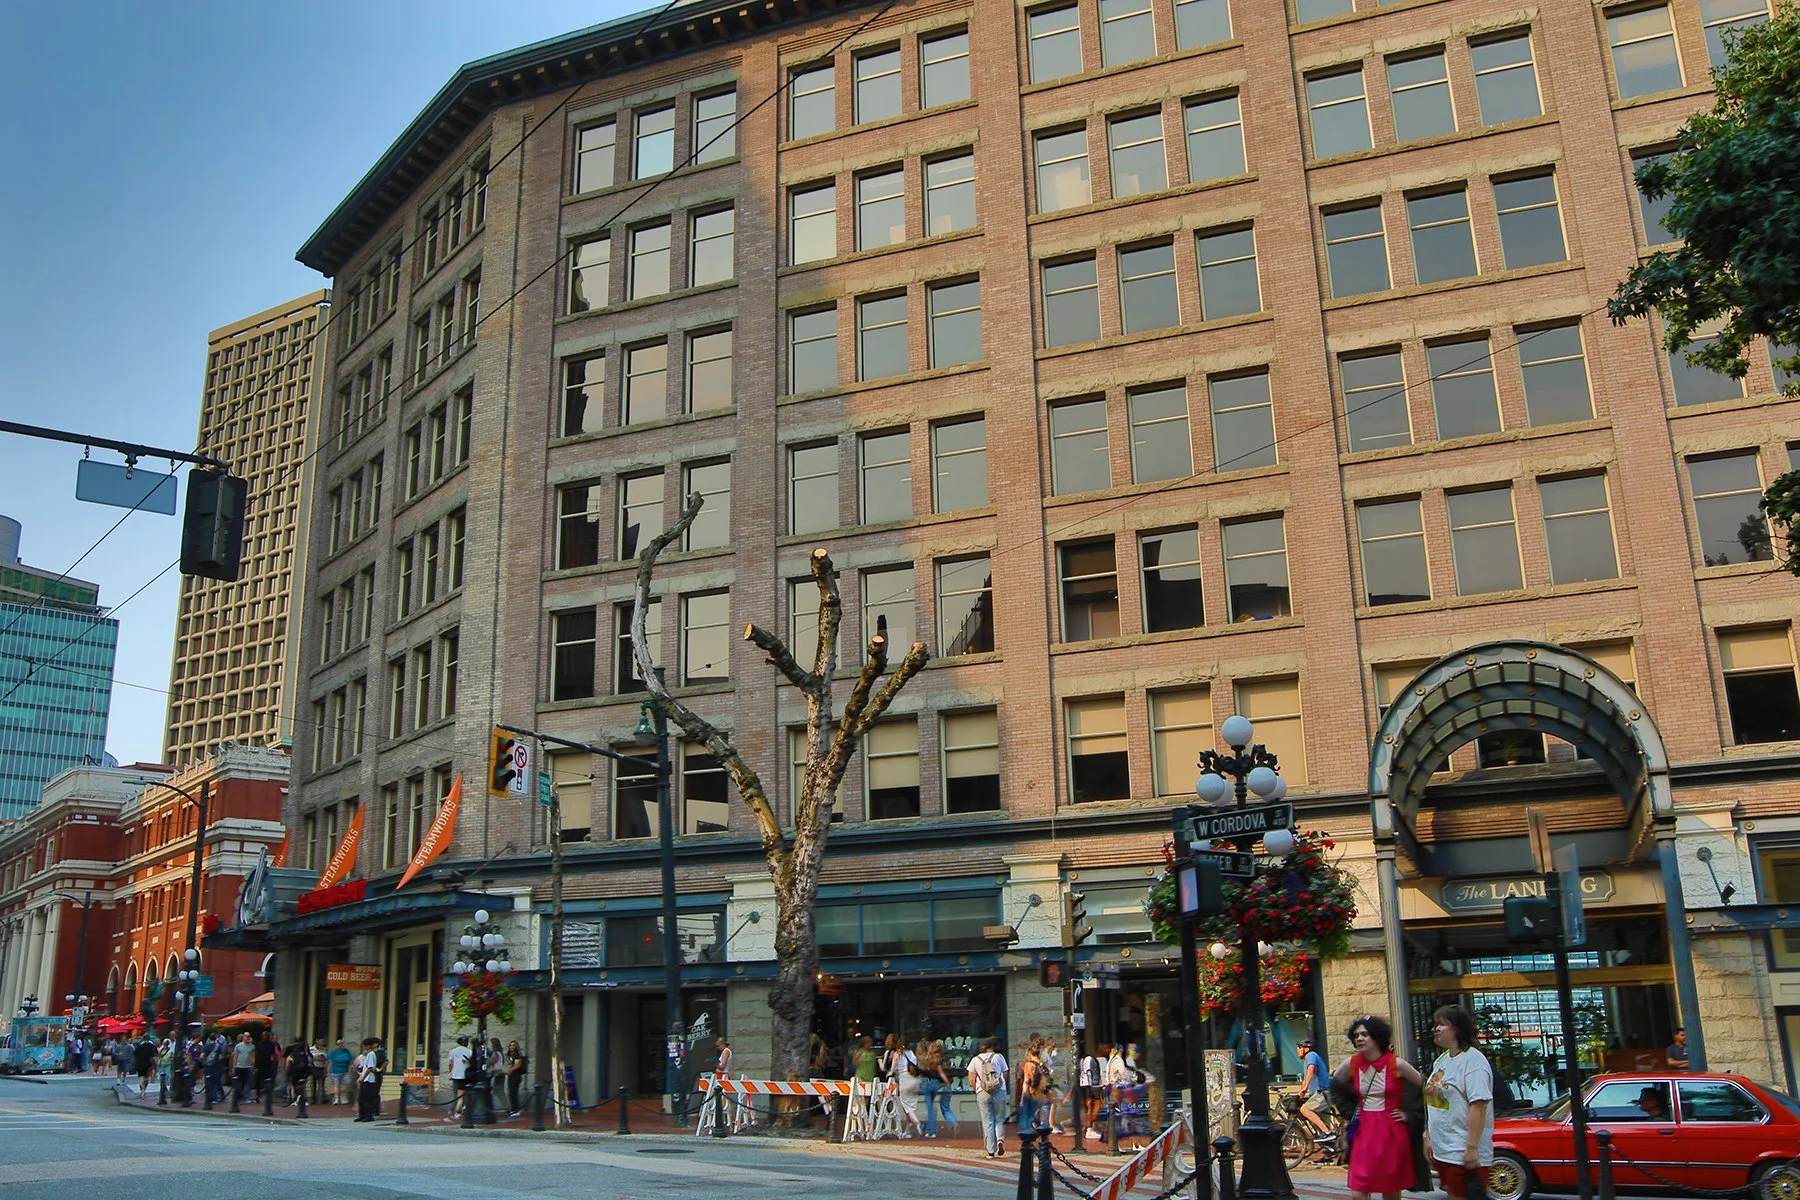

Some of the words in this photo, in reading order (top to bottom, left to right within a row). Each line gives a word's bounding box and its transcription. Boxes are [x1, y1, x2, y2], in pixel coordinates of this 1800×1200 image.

[1198, 820, 1209, 836] W
[1212, 812, 1267, 835] CORDOVA
[415, 799, 457, 867] STEAMWORKS
[319, 828, 359, 889] STEAMWORKS
[1456, 885, 1487, 901] The
[327, 971, 348, 980] COLD
[687, 1029, 712, 1041] BERRY
[691, 1025, 706, 1033] OAK
